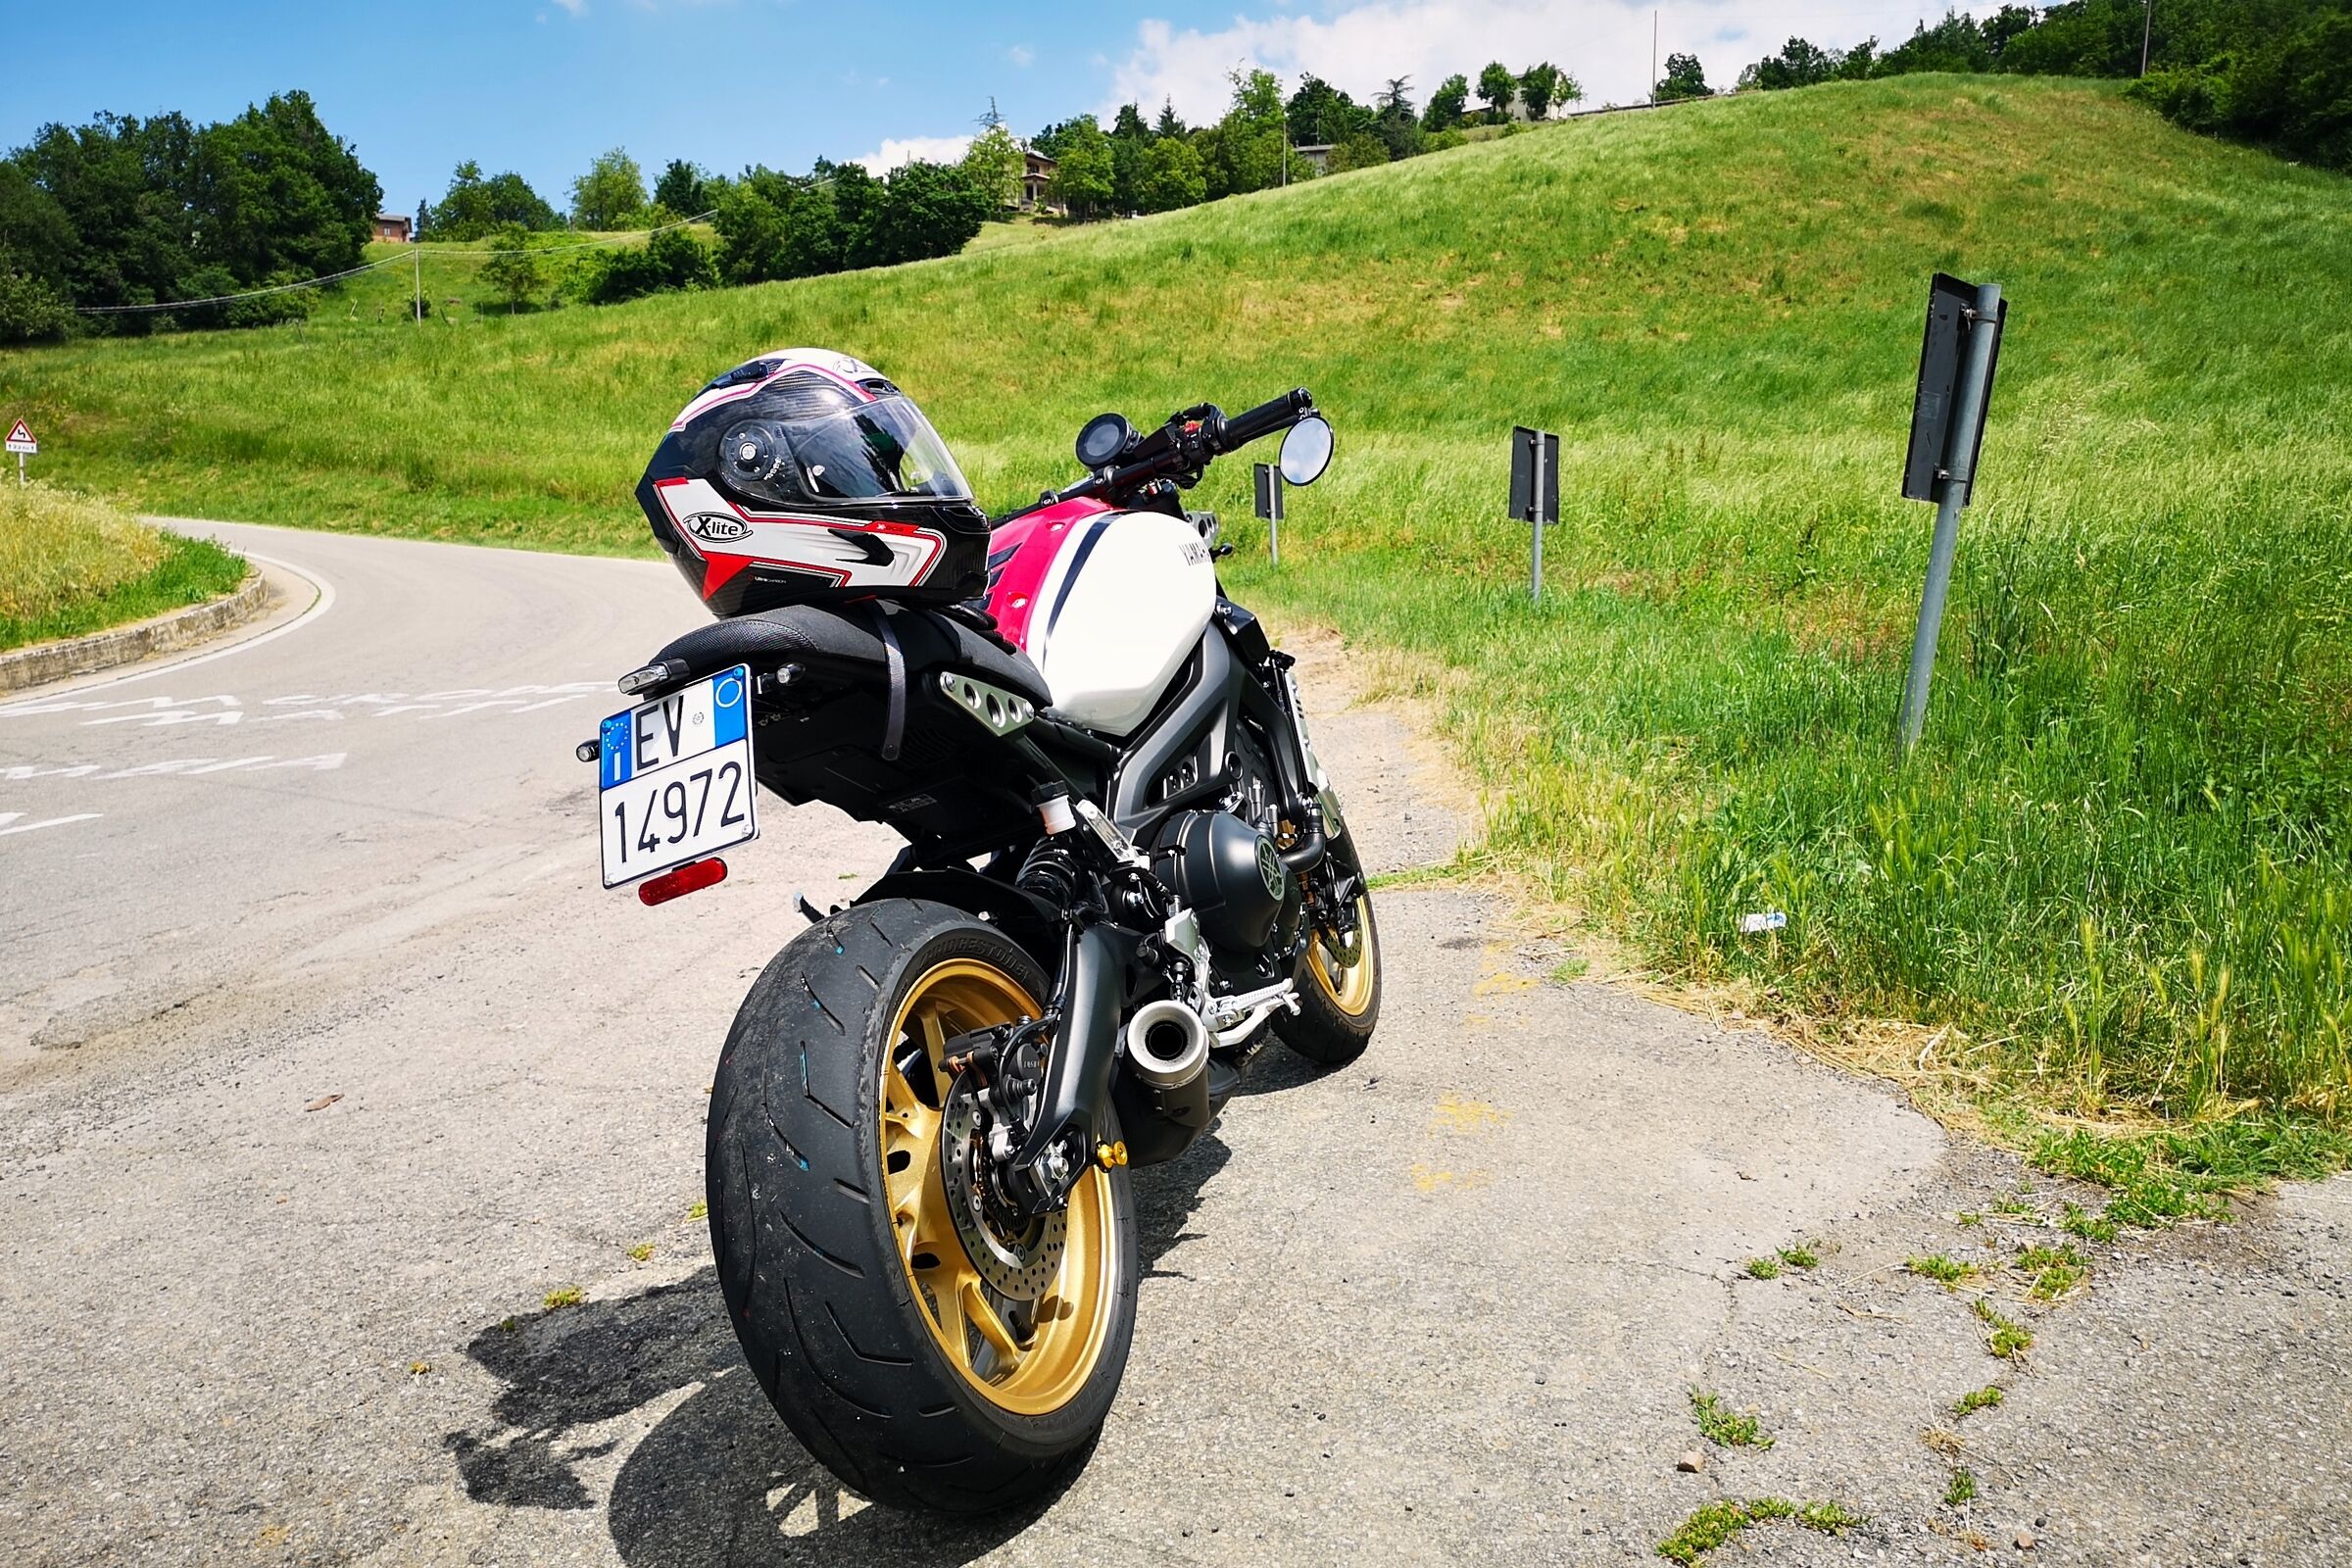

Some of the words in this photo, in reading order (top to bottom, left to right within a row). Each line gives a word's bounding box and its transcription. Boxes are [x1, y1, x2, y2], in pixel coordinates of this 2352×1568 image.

[695, 515, 739, 537] X-lite
[636, 695, 684, 770] EV
[614, 760, 745, 863] 14972
